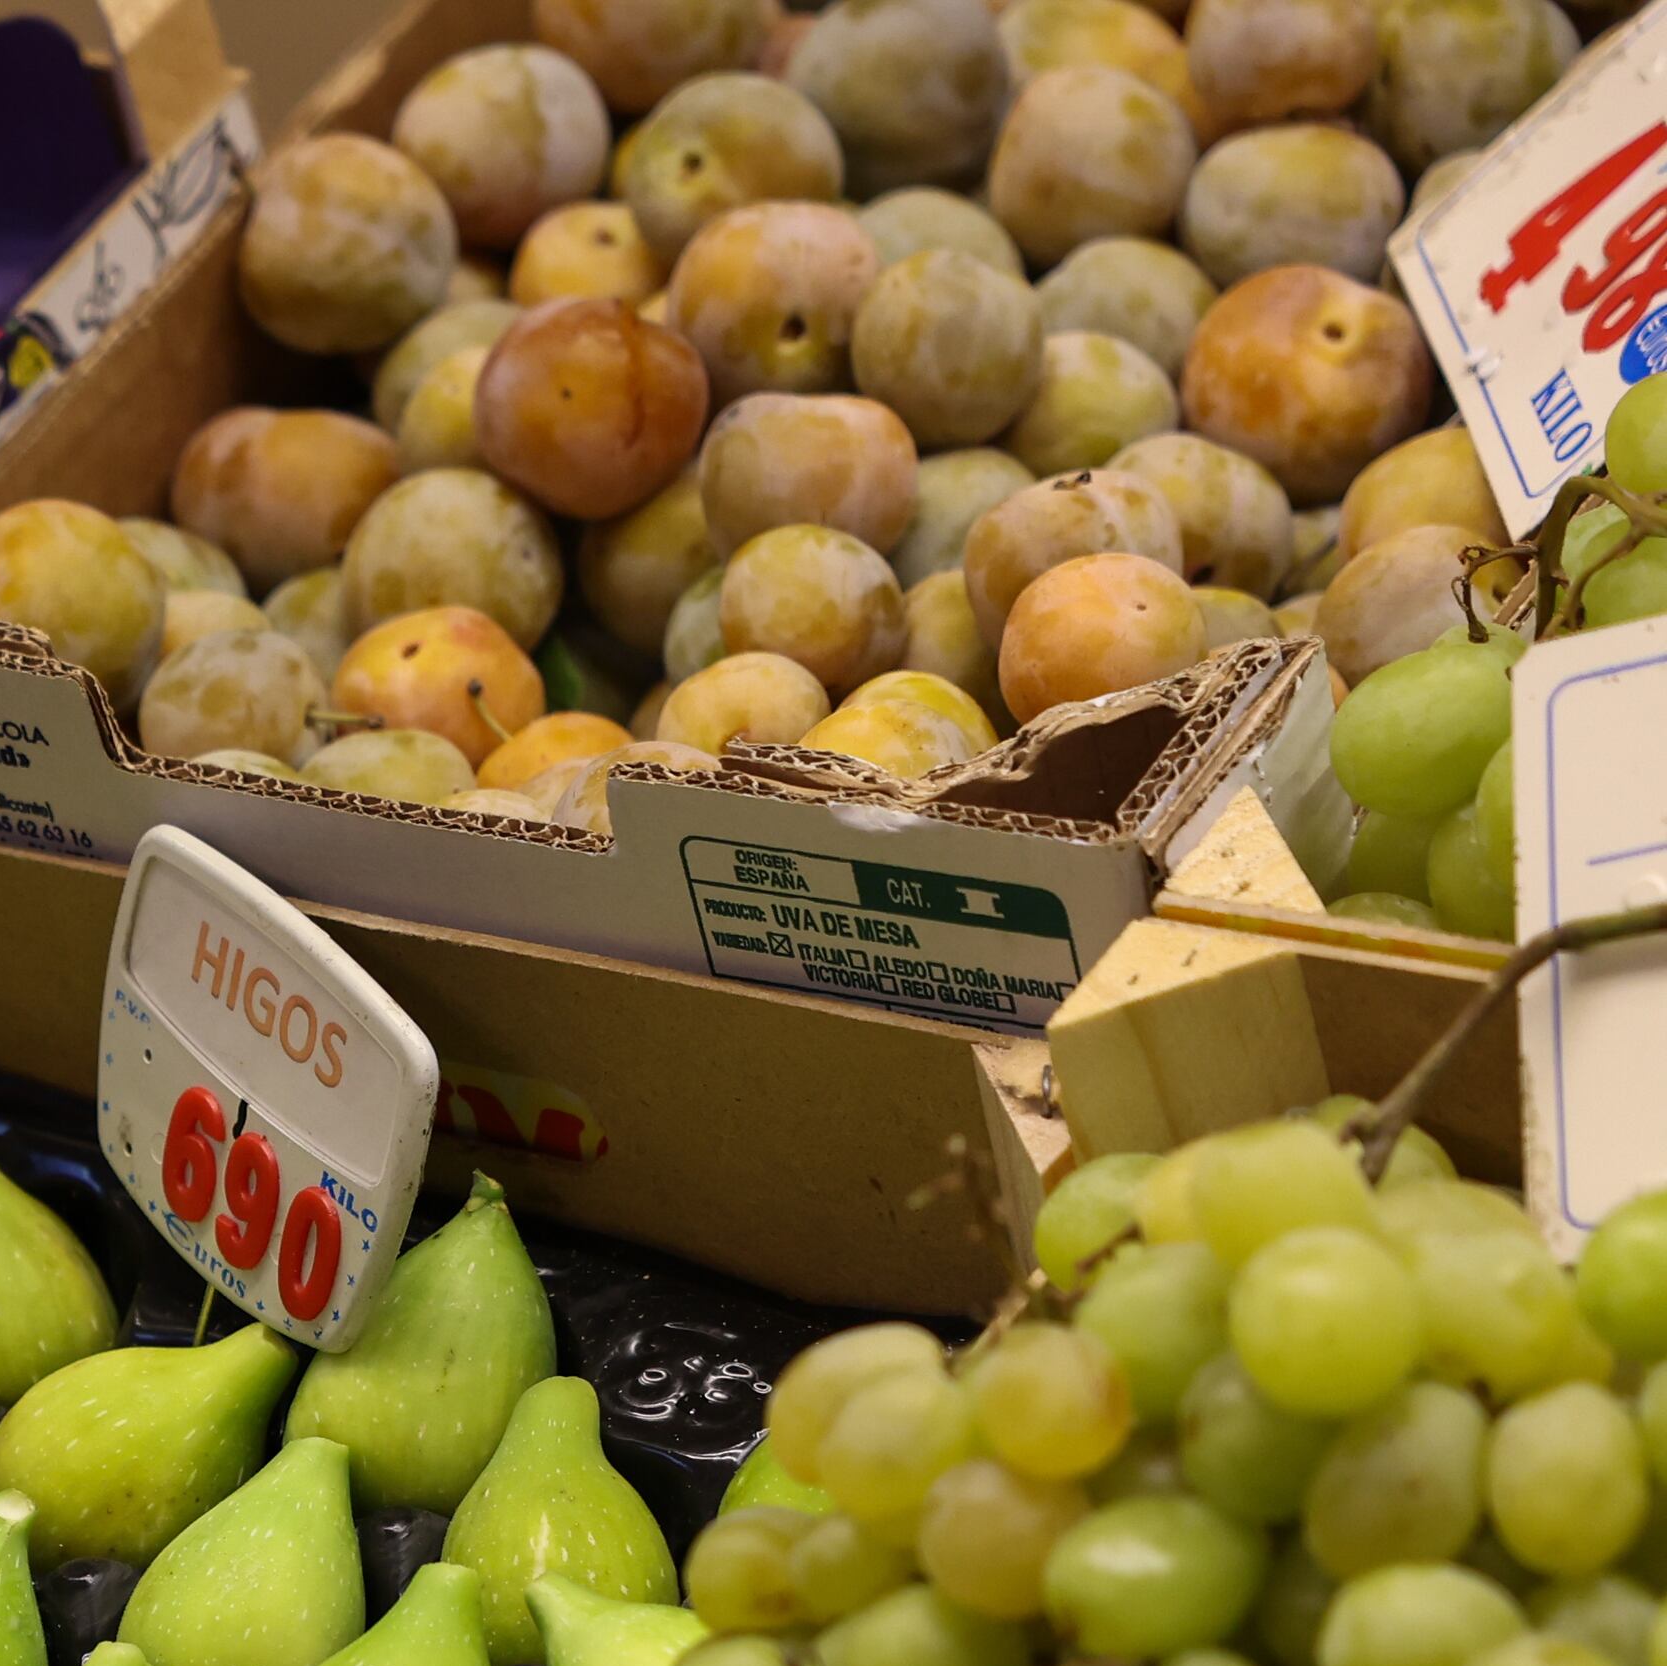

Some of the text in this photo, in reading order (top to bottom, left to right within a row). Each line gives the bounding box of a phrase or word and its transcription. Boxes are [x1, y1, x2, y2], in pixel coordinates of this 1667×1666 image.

[1531, 367, 1593, 463] KILO
[17, 819, 40, 839] 62
[43, 825, 65, 843] 63
[69, 829, 92, 849] 16
[734, 865, 810, 892] ESPAÑA
[735, 849, 799, 871] ORIGEN:
[703, 898, 921, 949] PRODUCTO: UVA DE MESA
[886, 878, 1005, 919] CAT. I
[711, 930, 1058, 1000] VARIEDAD: ITALIA ALEDO DOÑA MARIA
[802, 963, 997, 1010] VICTORIA RED GLOBE
[191, 920, 348, 1089] HIGOS
[318, 1170, 379, 1233] KILO
[161, 1209, 248, 1299] Euros
